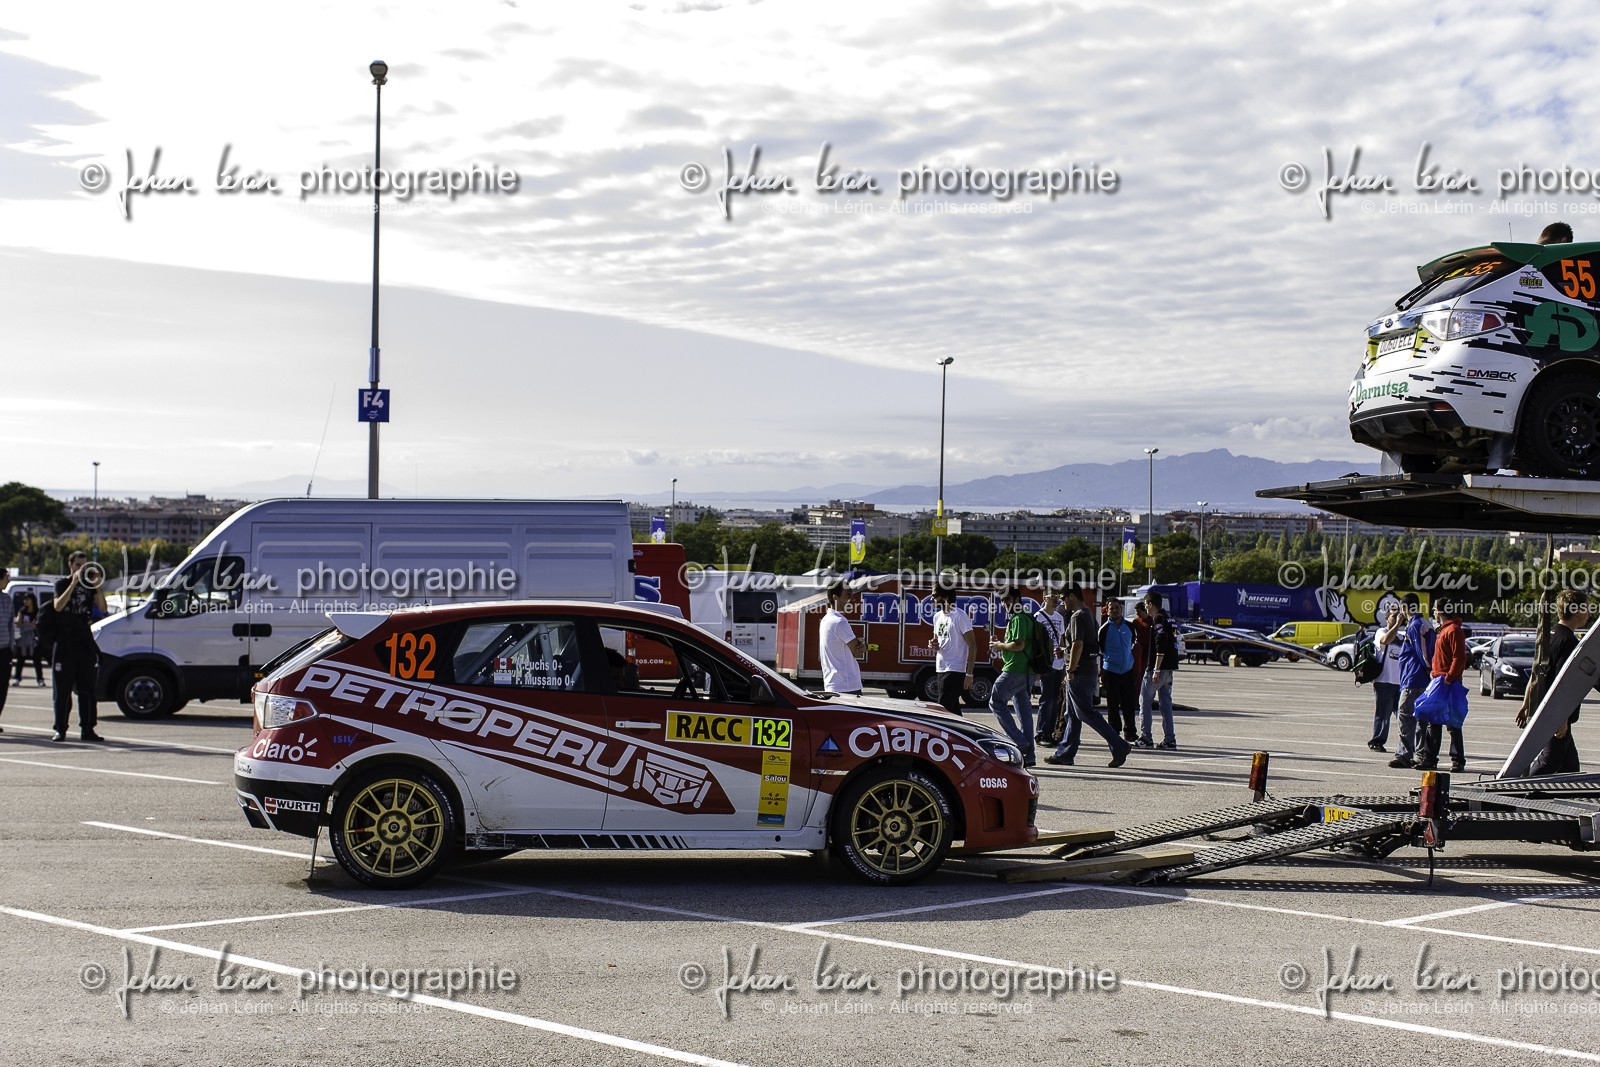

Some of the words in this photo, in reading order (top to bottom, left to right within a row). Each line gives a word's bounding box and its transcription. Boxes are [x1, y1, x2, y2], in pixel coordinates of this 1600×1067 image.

[1560, 259, 1596, 299] 55
[363, 391, 384, 408] F4
[1248, 595, 1289, 603] MICHELIN
[385, 632, 436, 680] 132
[675, 714, 743, 742] RACC
[754, 719, 791, 747] 132
[848, 724, 950, 762] Claro
[253, 736, 304, 762] Claro
[979, 777, 1008, 789] COSAS
